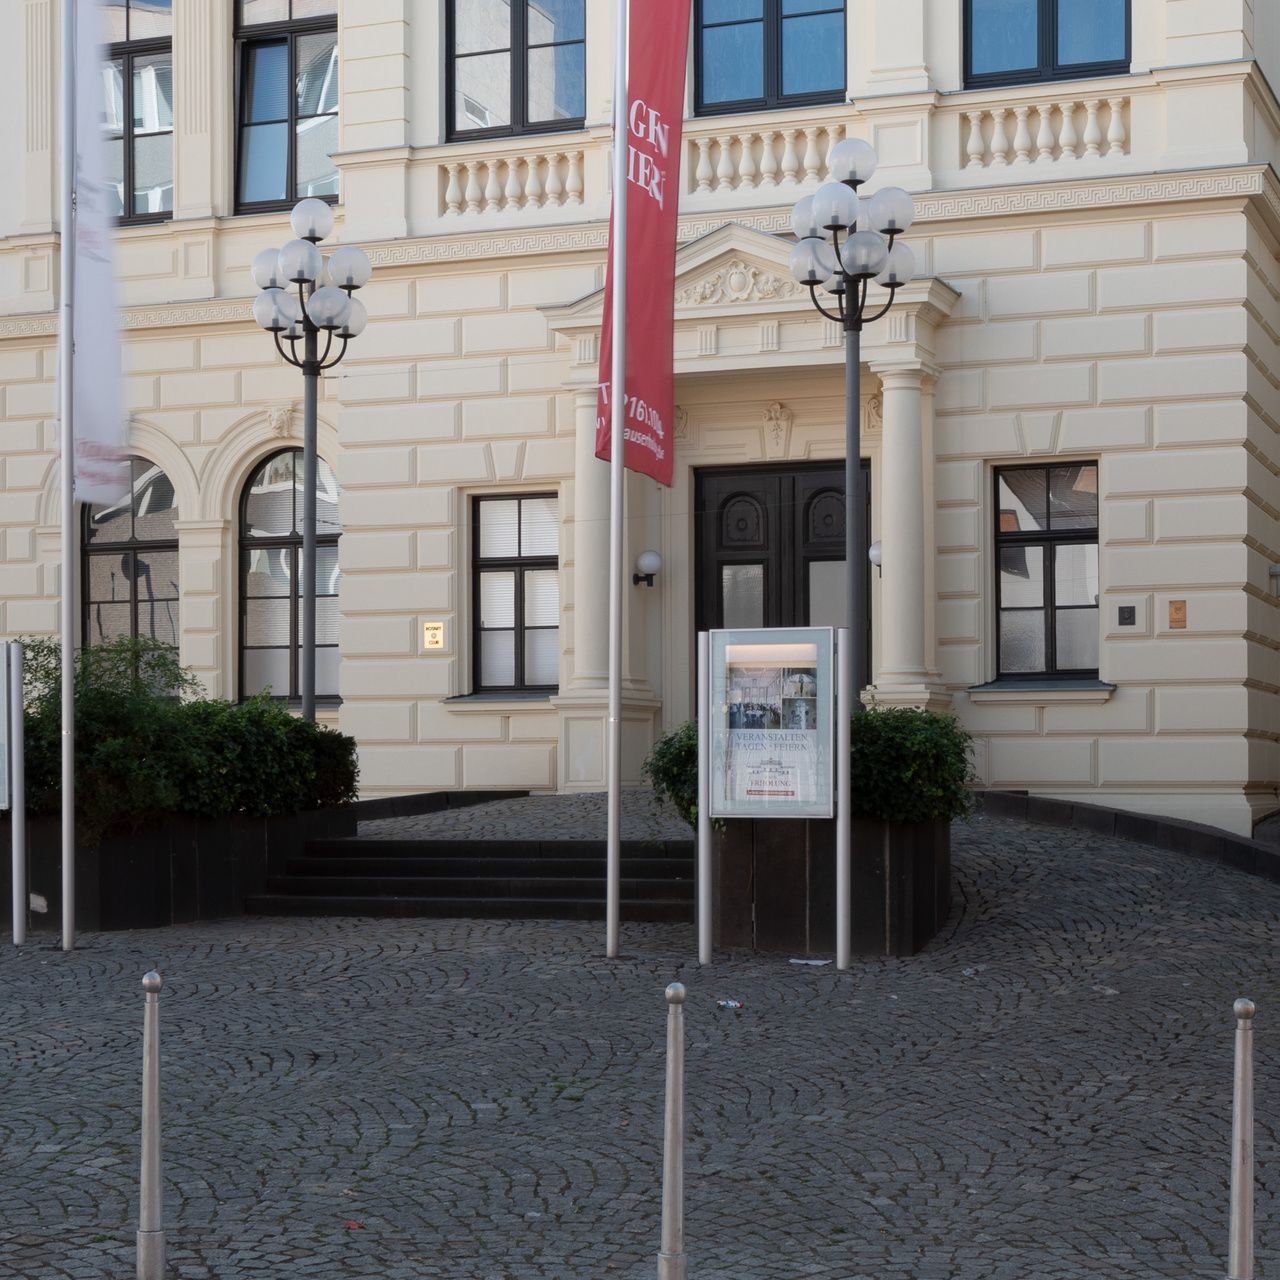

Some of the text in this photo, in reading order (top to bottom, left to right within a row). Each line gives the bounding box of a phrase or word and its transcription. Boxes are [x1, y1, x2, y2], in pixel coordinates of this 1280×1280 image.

[736, 732, 808, 741] VERANSTALTEN
[735, 742, 808, 751] TAGEN FEIERN
